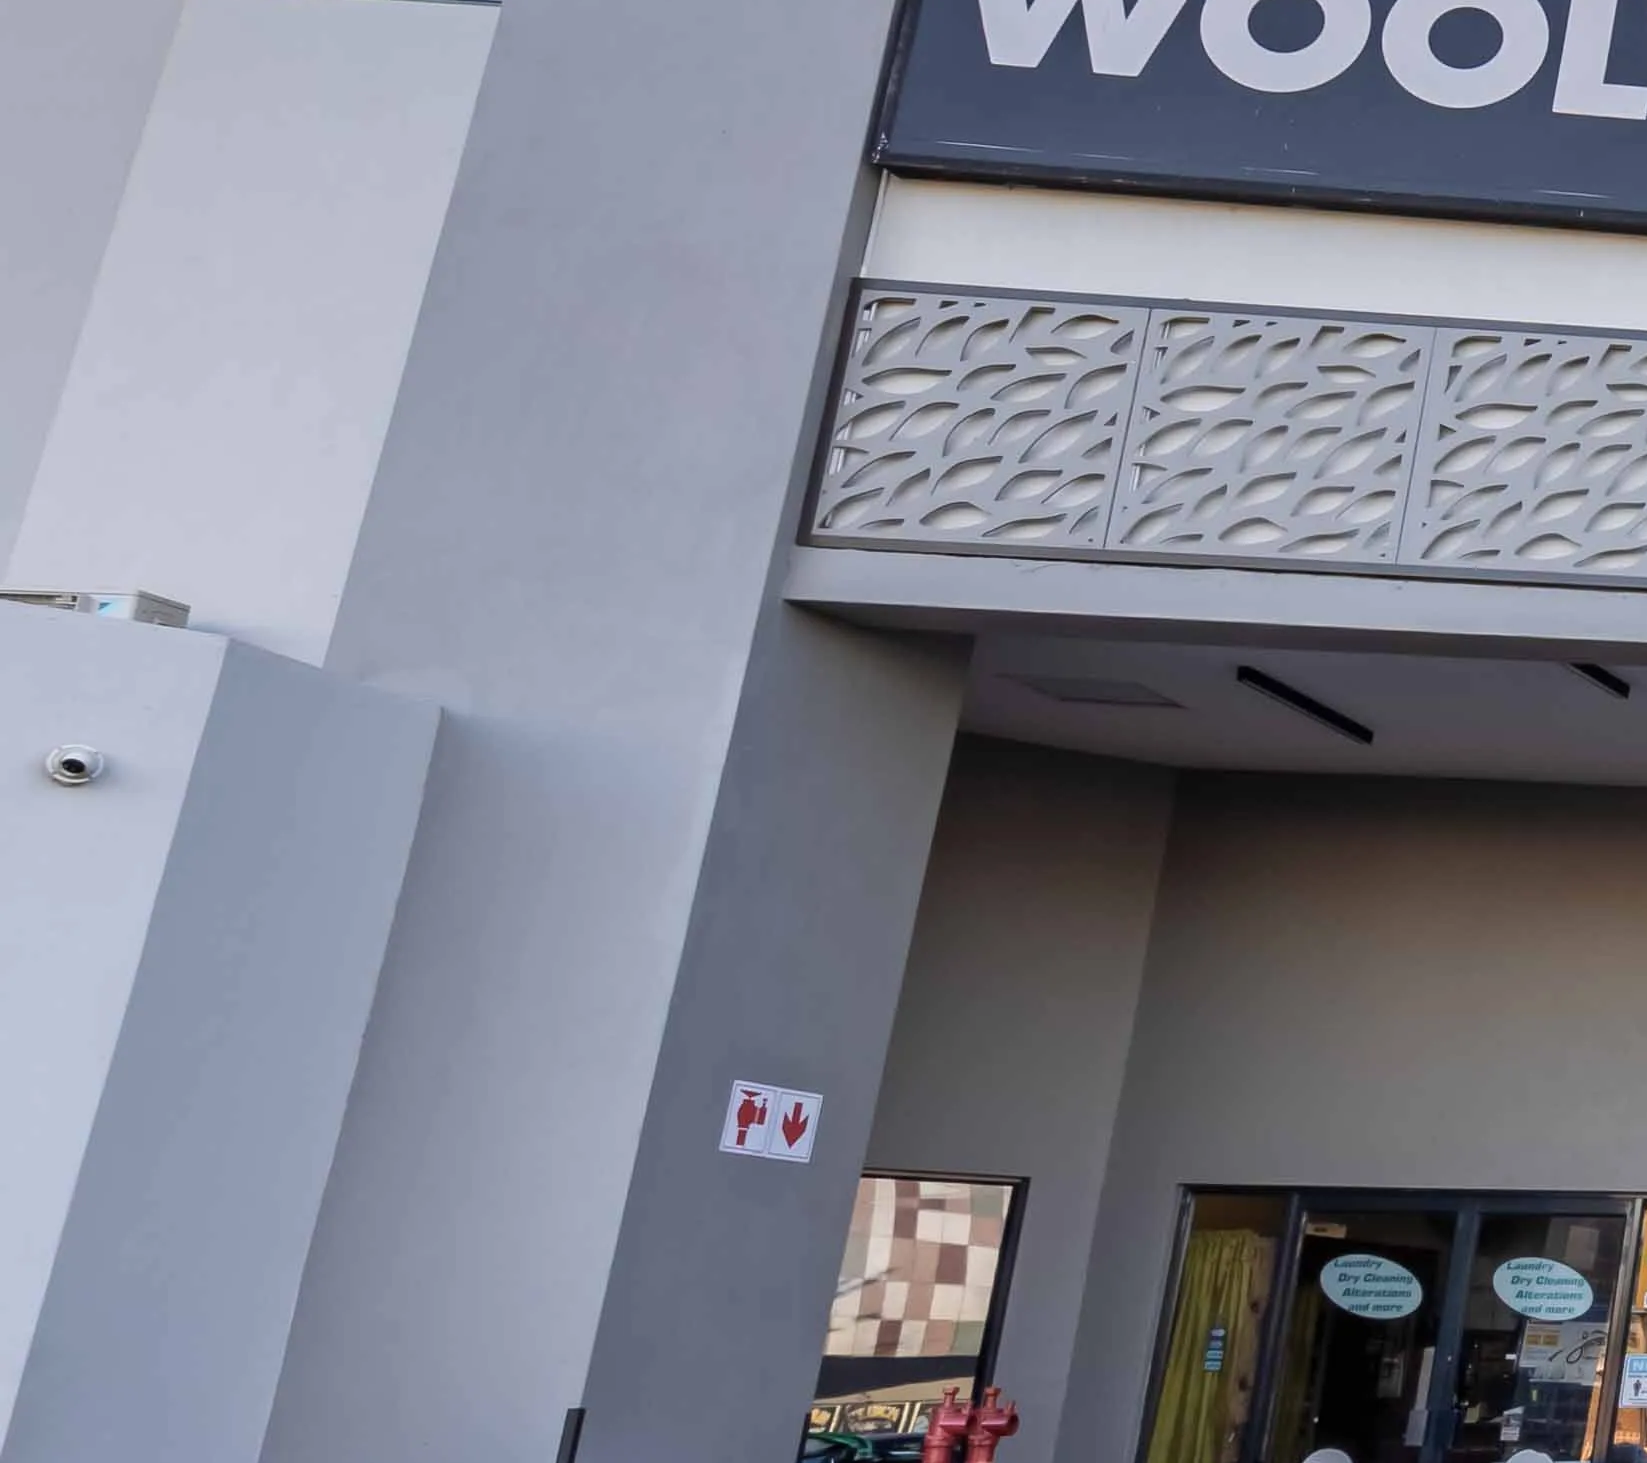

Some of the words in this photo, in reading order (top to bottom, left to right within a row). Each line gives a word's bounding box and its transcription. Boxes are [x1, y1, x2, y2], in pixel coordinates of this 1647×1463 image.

[1334, 1259, 1383, 1270] Laundry
[1506, 1261, 1555, 1272] Laundry
[1338, 1273, 1360, 1284] Dry
[1363, 1273, 1414, 1285] Cleaning
[1511, 1275, 1534, 1286] Dry
[1536, 1275, 1585, 1287] Cleaning
[1342, 1287, 1412, 1297] Alterations
[1515, 1290, 1584, 1300] Alterations
